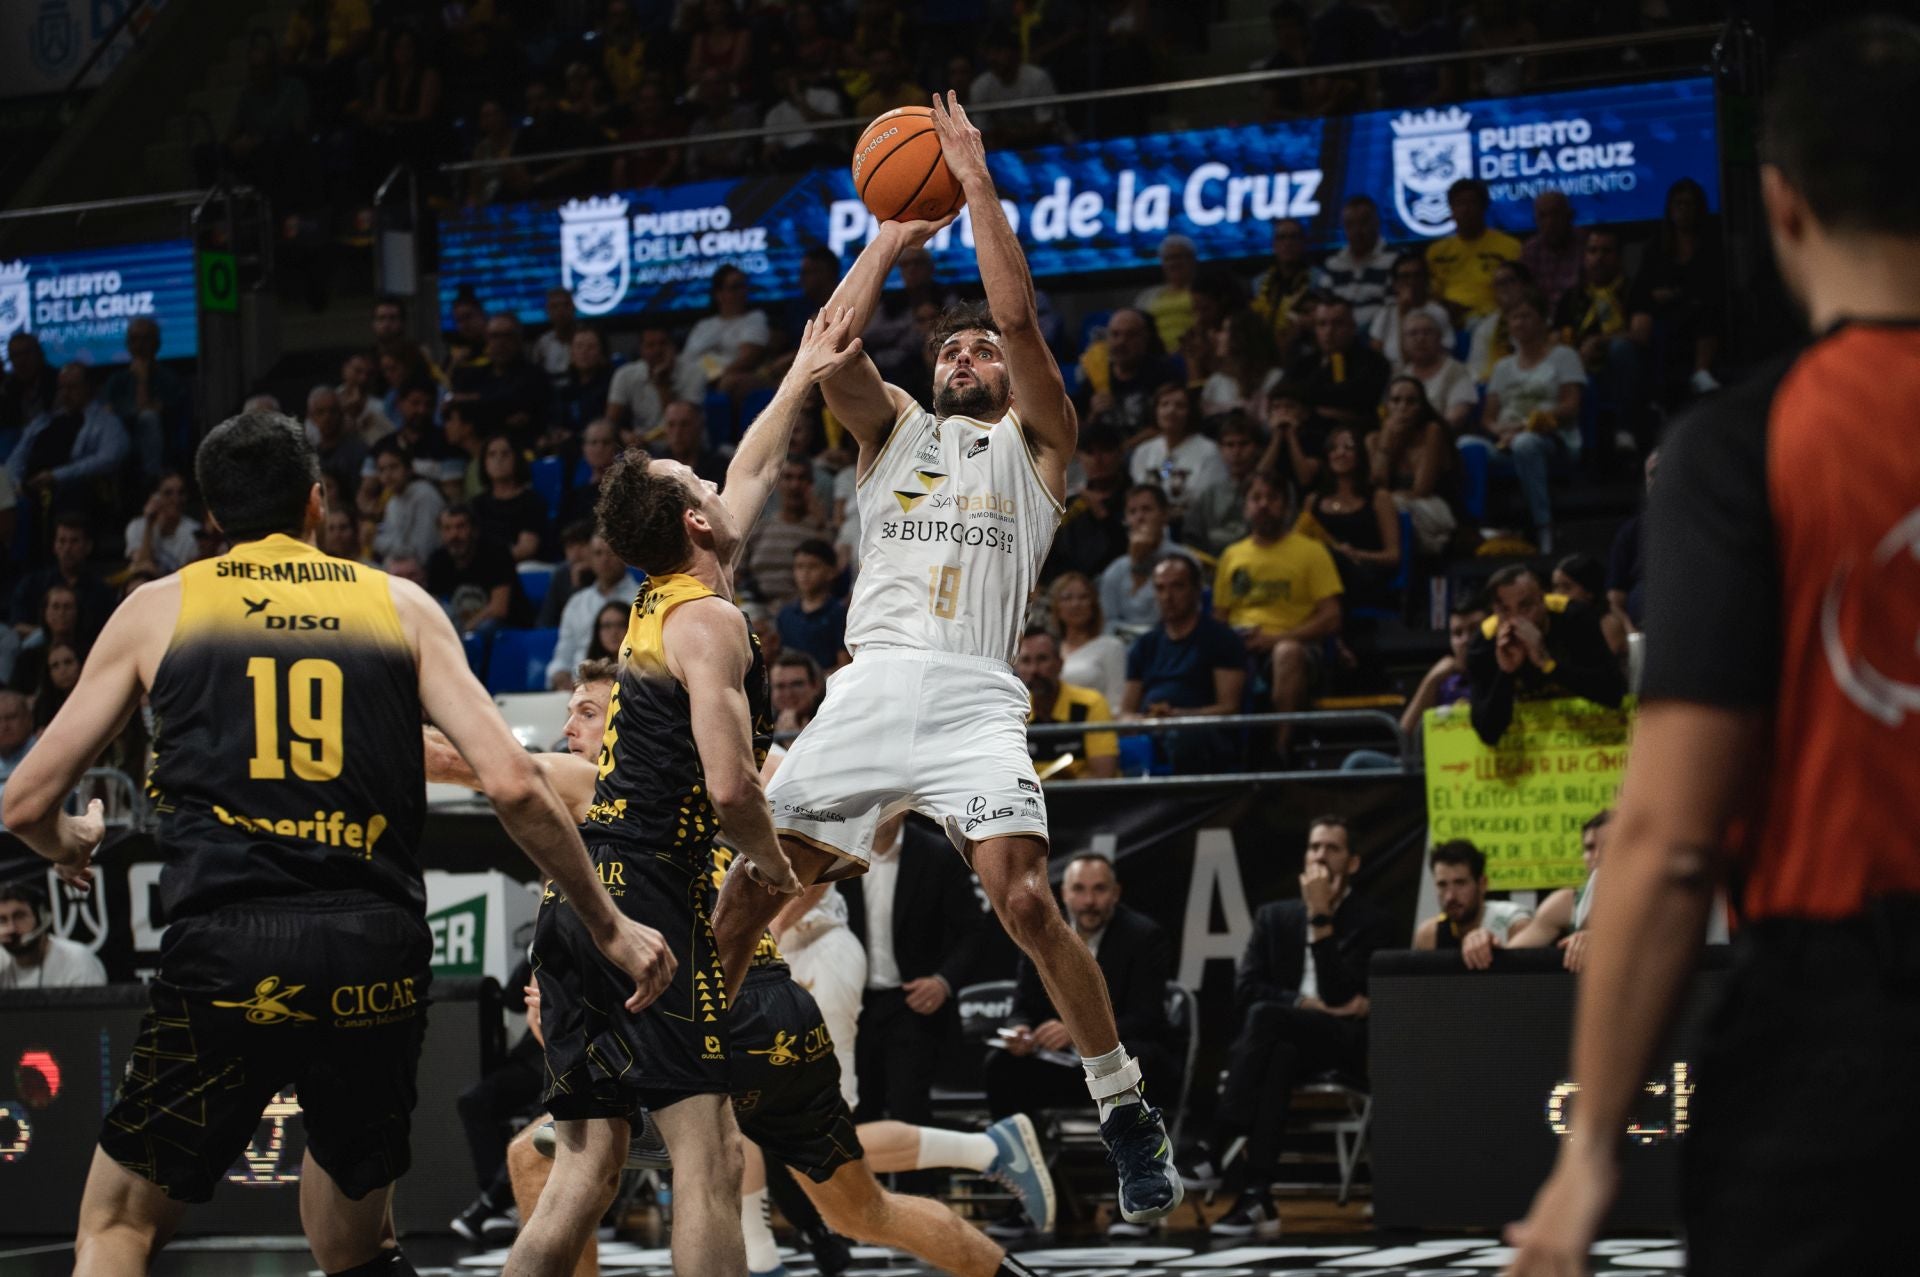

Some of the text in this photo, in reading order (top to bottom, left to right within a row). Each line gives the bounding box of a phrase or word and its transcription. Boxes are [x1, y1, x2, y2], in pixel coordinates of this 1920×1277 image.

[1479, 118, 1592, 152] PUERTO
[1556, 141, 1636, 172] CRUZ
[1031, 176, 1103, 242] de
[1116, 169, 1171, 234] la
[1184, 161, 1323, 226] Cruz
[633, 206, 732, 237] PUERTO
[700, 226, 768, 256] CRUZ
[35, 271, 121, 300] PUERTO
[95, 292, 154, 319] CRUZ
[957, 489, 1016, 515] pablo
[900, 521, 998, 548] BURGOS
[216, 561, 358, 585] SHERMADINI
[929, 564, 962, 621] 19
[246, 656, 344, 782] 19
[965, 806, 1015, 832] EXUS
[331, 978, 417, 1017] CICAR
